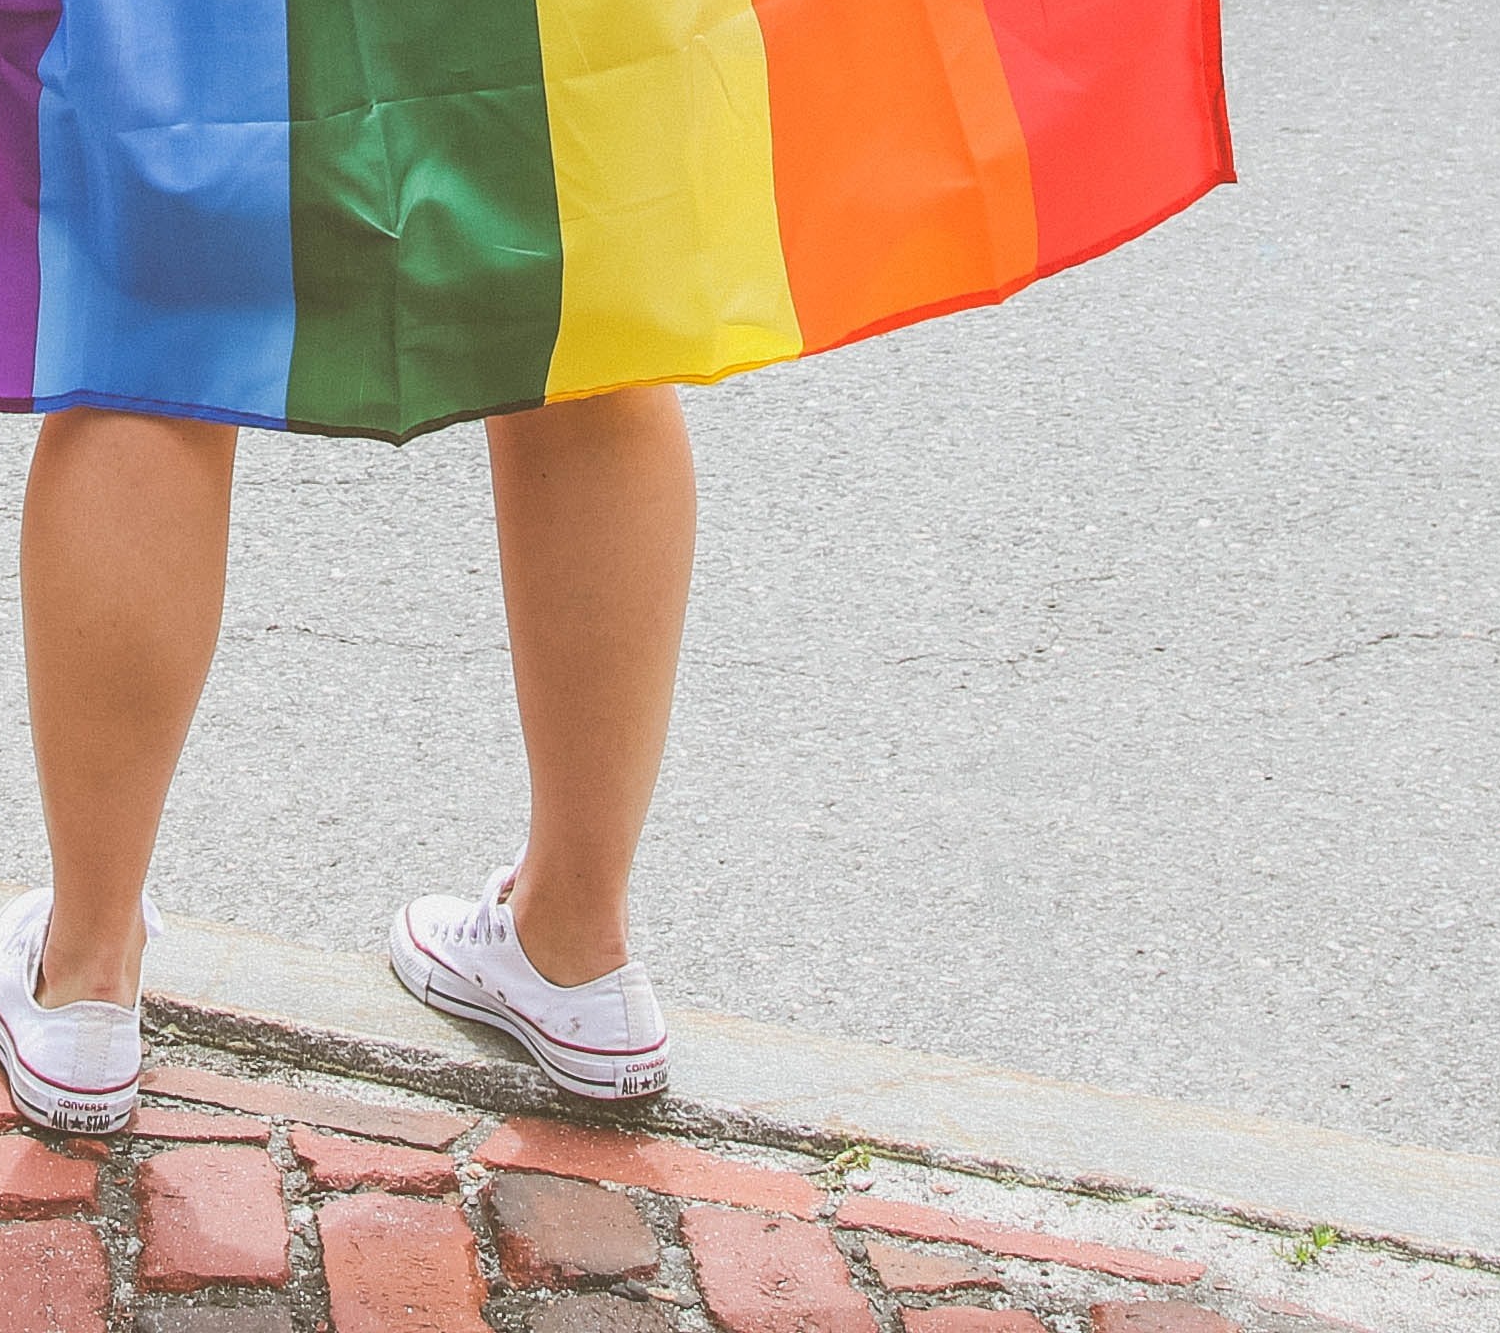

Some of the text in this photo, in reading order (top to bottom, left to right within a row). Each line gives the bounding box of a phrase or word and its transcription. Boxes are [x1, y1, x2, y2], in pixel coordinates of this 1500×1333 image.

[625, 1054, 669, 1073] CONVERS
[621, 1064, 671, 1095] ALL STA
[57, 1098, 109, 1112] CONVERSE
[51, 1110, 110, 1132] ALL STAR
